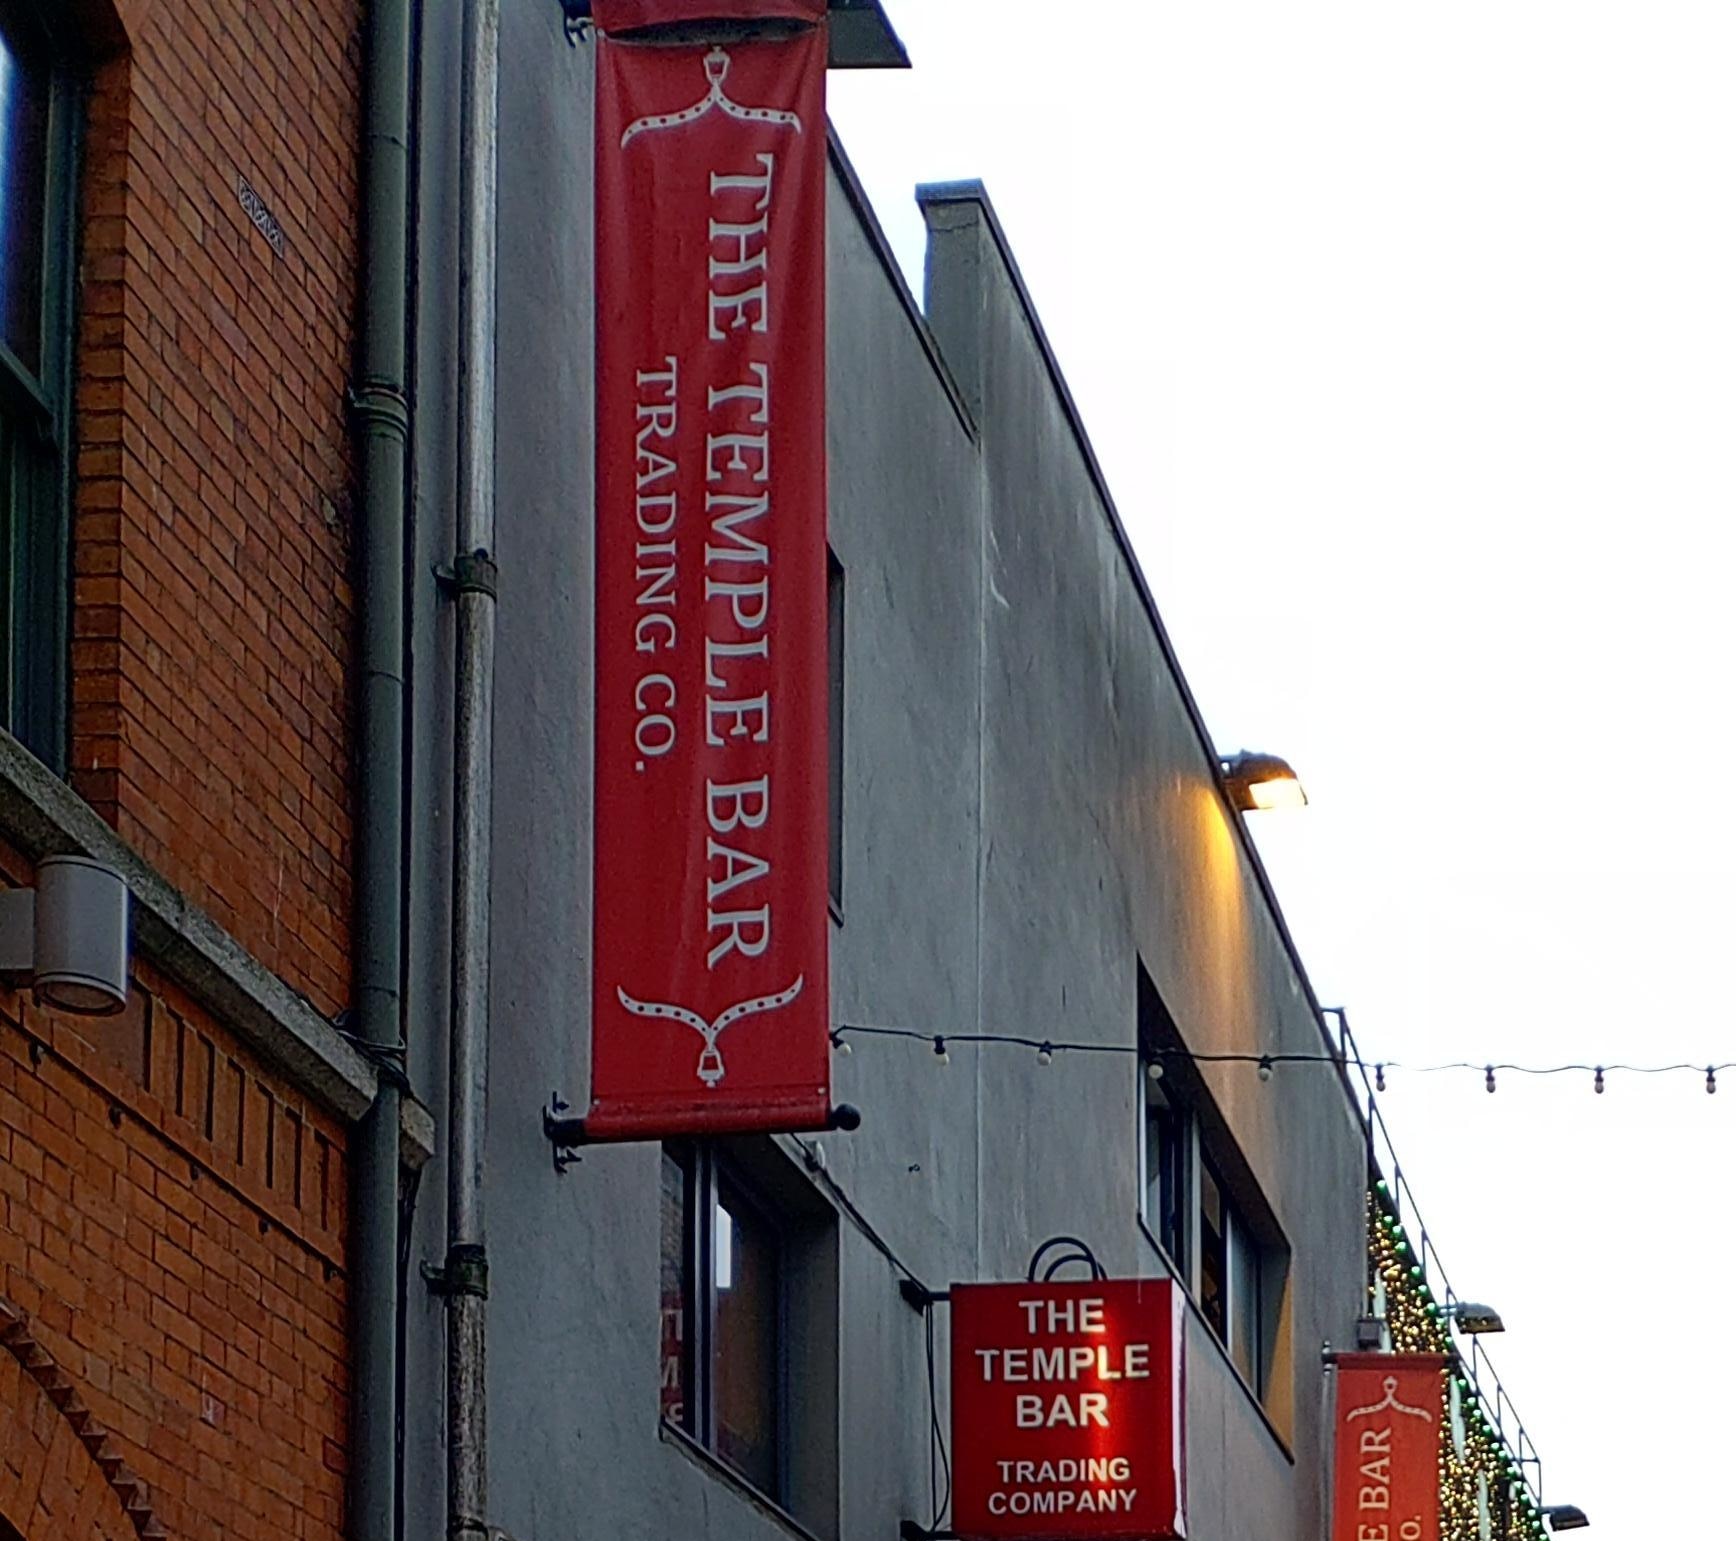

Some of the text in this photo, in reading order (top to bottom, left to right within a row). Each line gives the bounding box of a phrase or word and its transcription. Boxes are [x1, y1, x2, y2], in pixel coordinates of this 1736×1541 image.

[633, 355, 679, 773] TRADING CO.
[706, 154, 774, 969] THE TEMPLE BAR
[1019, 1299, 1106, 1334] THE
[975, 1344, 1150, 1381] TEMPLE
[1016, 1392, 1109, 1428] BAR
[997, 1457, 1131, 1484] TRADING
[1358, 1426, 1392, 1510] BAR
[988, 1489, 1137, 1515] COMPANY
